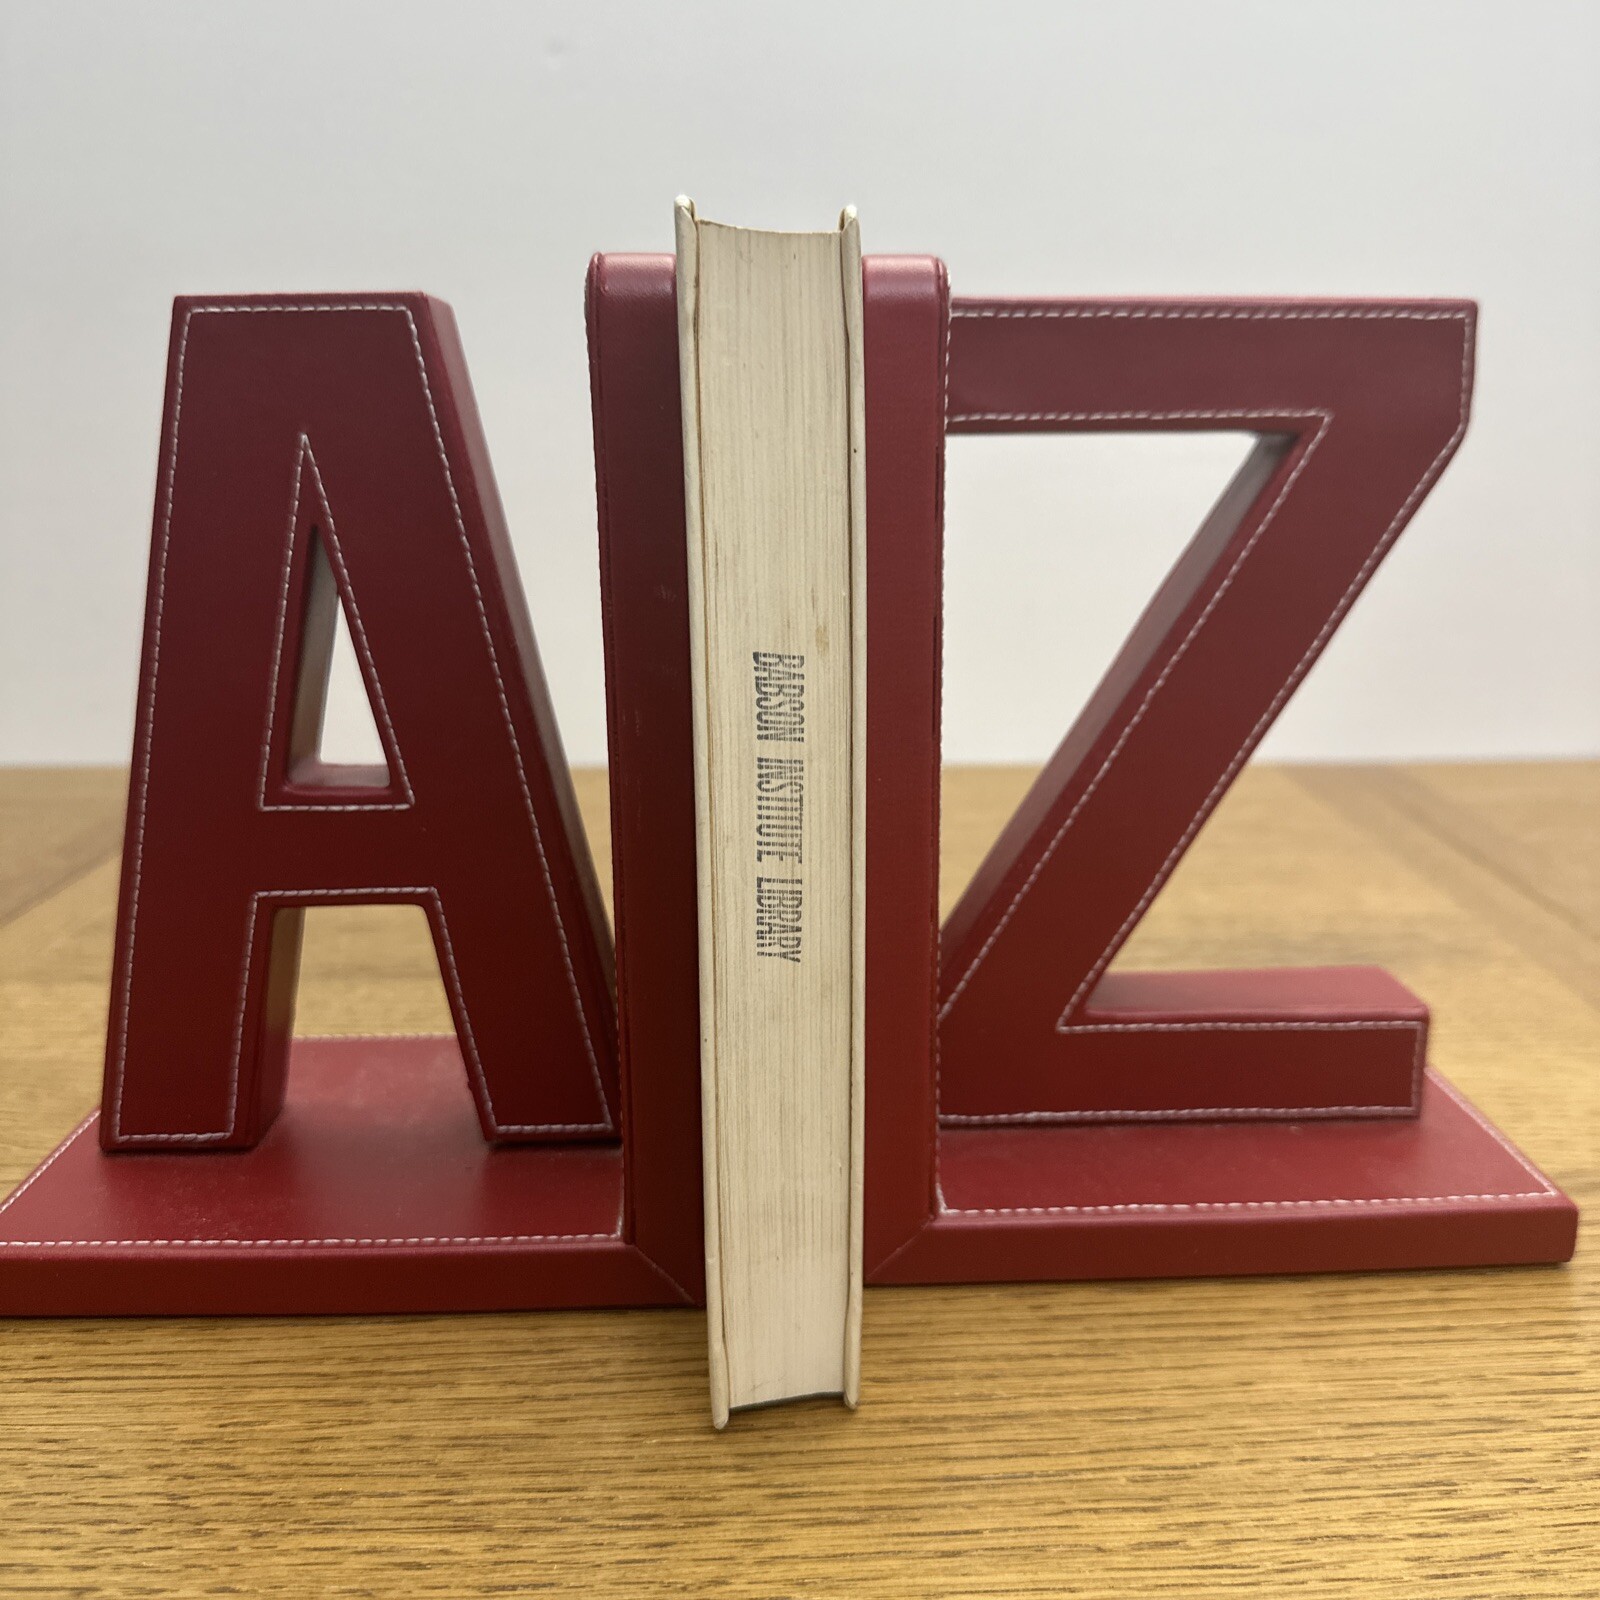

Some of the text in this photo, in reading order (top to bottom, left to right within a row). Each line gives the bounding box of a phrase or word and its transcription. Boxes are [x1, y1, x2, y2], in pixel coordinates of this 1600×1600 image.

[100, 291, 622, 1151] A
[753, 651, 805, 963] BABSON INSTITUTE LIBRARY
[937, 297, 1479, 1127] Z
